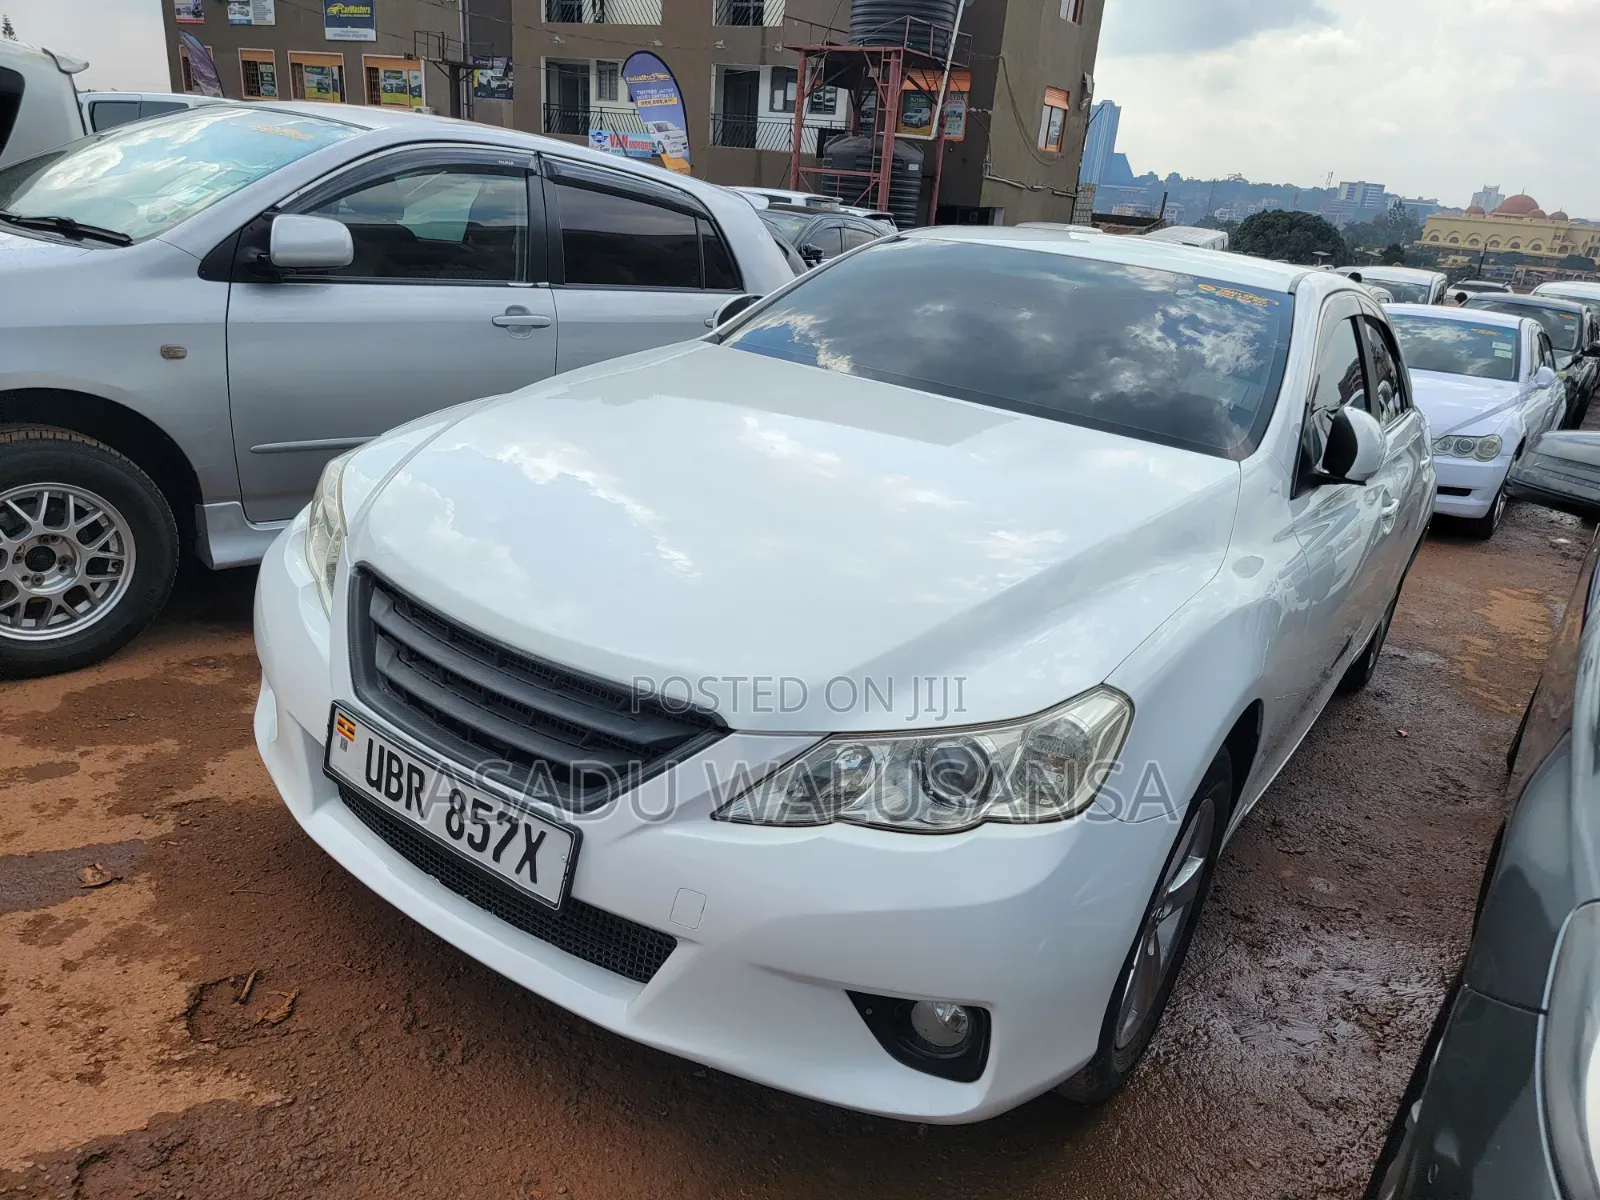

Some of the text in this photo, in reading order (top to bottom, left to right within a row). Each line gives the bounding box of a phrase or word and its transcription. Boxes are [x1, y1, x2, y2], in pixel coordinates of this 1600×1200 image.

[610, 134, 629, 149] VAN
[629, 140, 652, 150] MOTORS
[365, 738, 547, 884] UBR 857X
